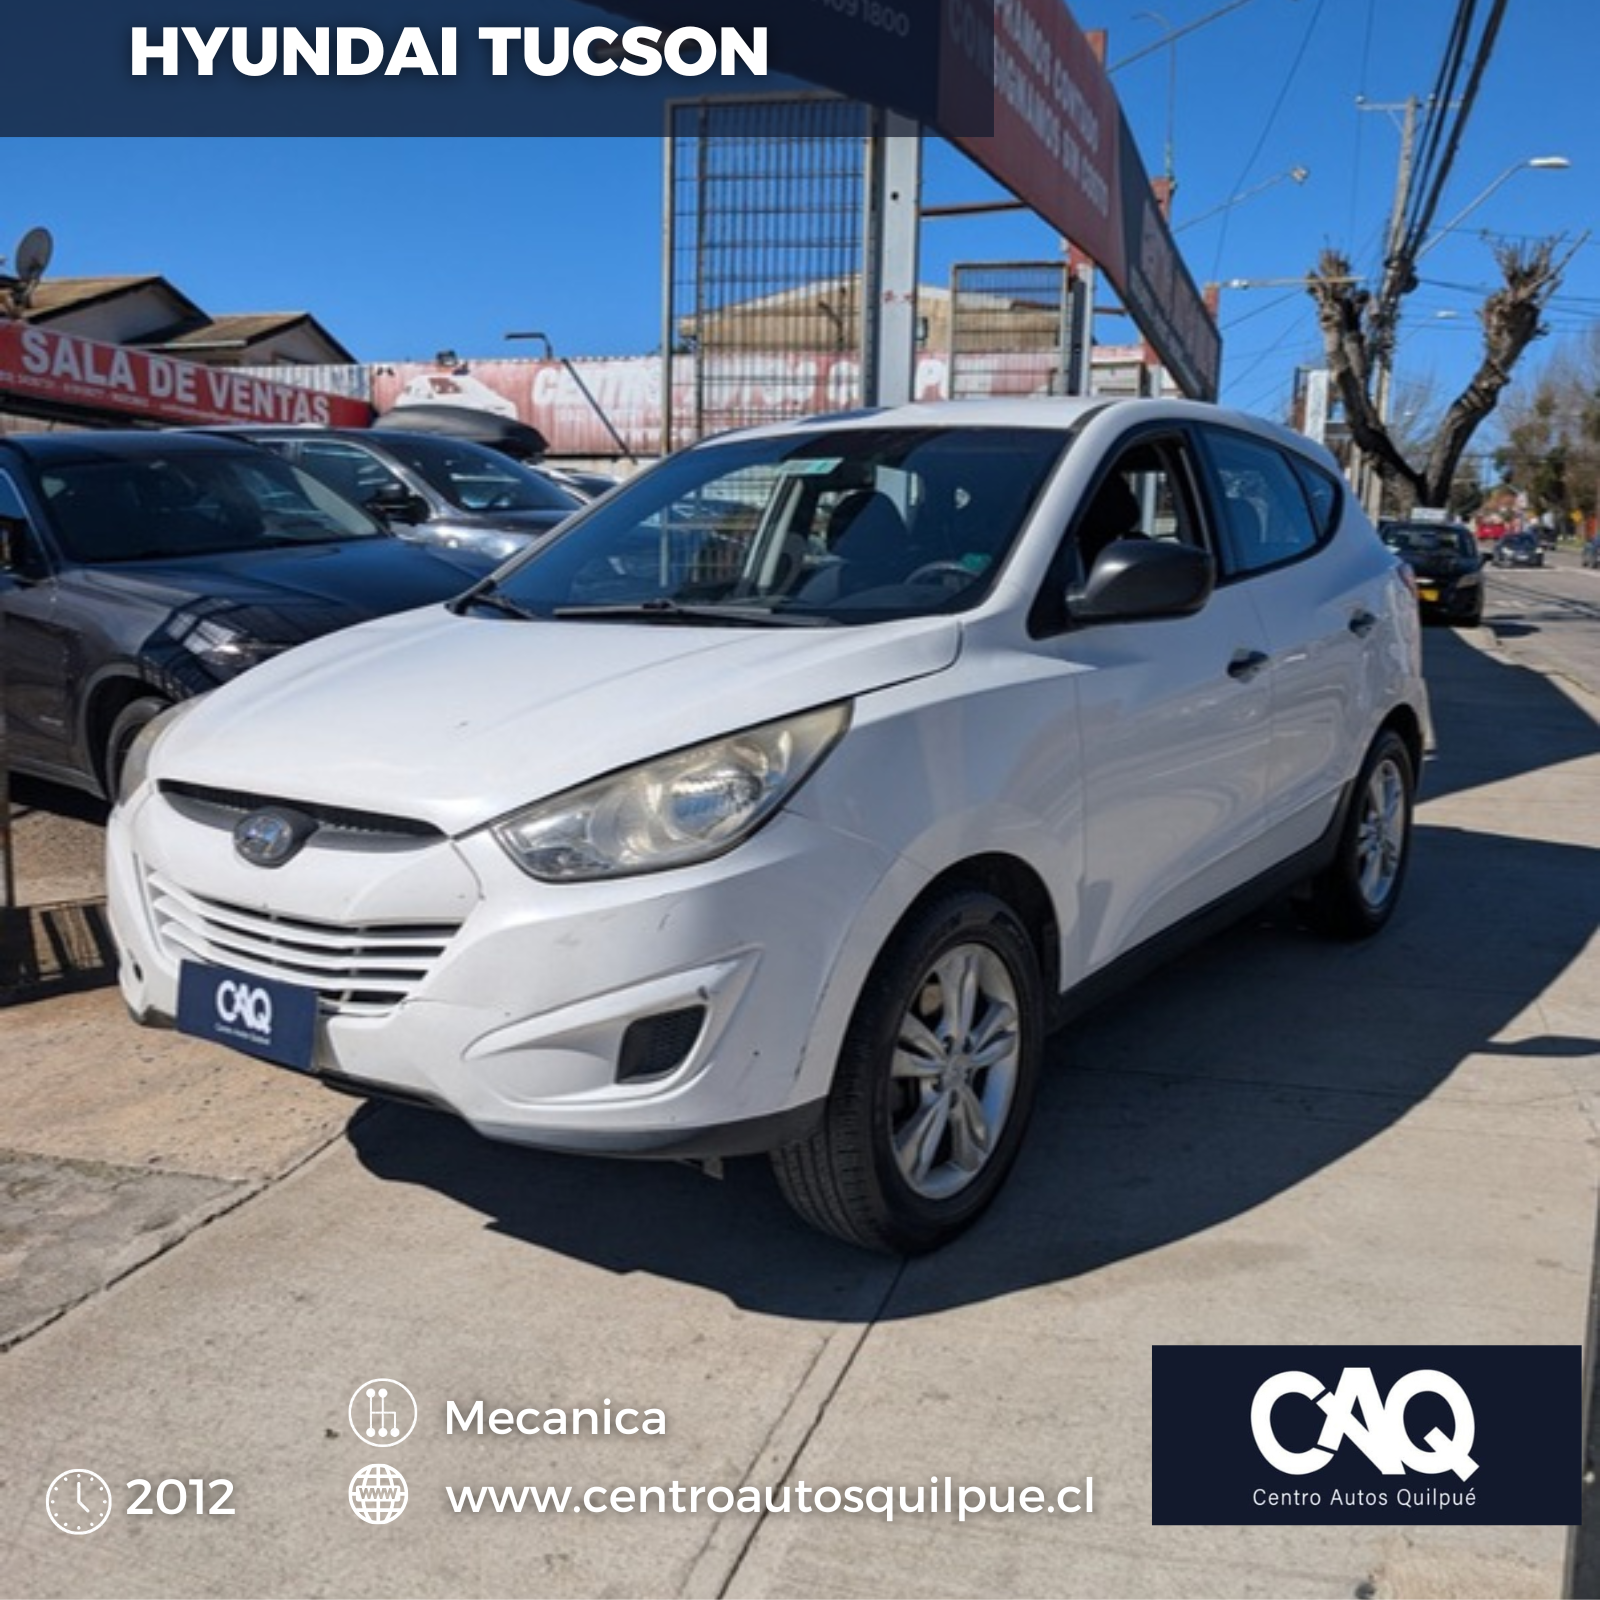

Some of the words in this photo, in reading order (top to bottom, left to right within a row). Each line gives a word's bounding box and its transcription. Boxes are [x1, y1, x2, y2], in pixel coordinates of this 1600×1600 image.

[21, 328, 135, 392] SALA
[148, 357, 197, 403] DE
[208, 367, 331, 425] VENTAS
[216, 980, 272, 1034] CAQ
